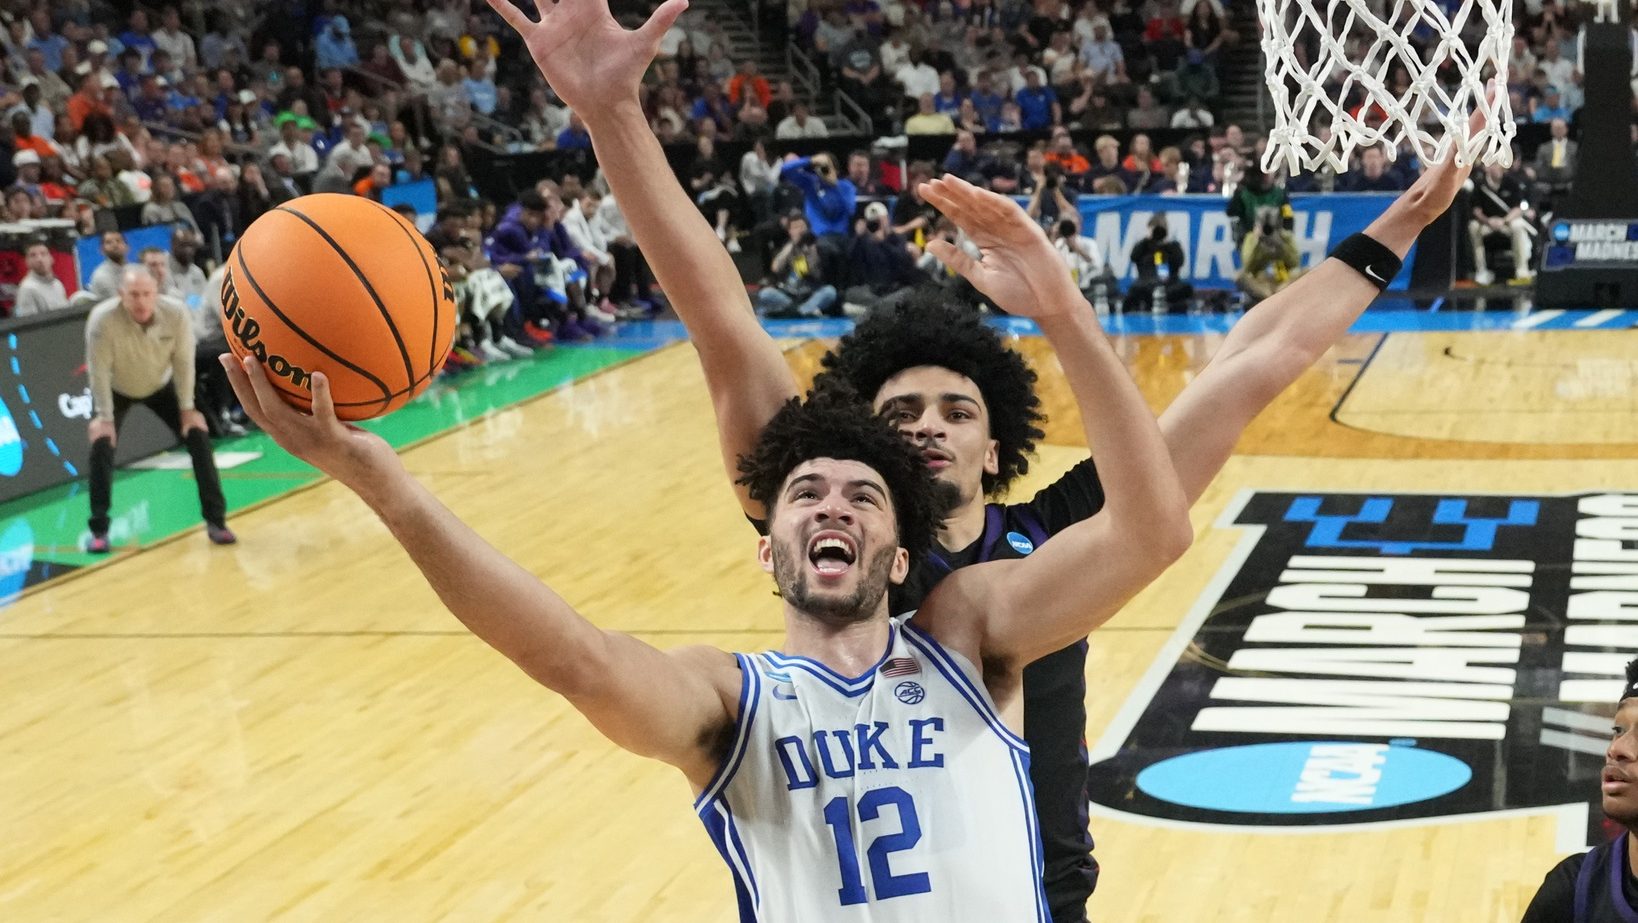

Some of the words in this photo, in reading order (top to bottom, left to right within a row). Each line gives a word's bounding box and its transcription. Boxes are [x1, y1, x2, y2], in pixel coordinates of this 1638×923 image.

[1092, 210, 1333, 279] MARH
[1568, 223, 1628, 241] MARCH
[221, 264, 312, 392] Wilson
[1191, 555, 1536, 740] MARCH
[775, 717, 945, 791] DUKE
[1290, 743, 1391, 806] NCAA
[823, 786, 932, 906] 12
